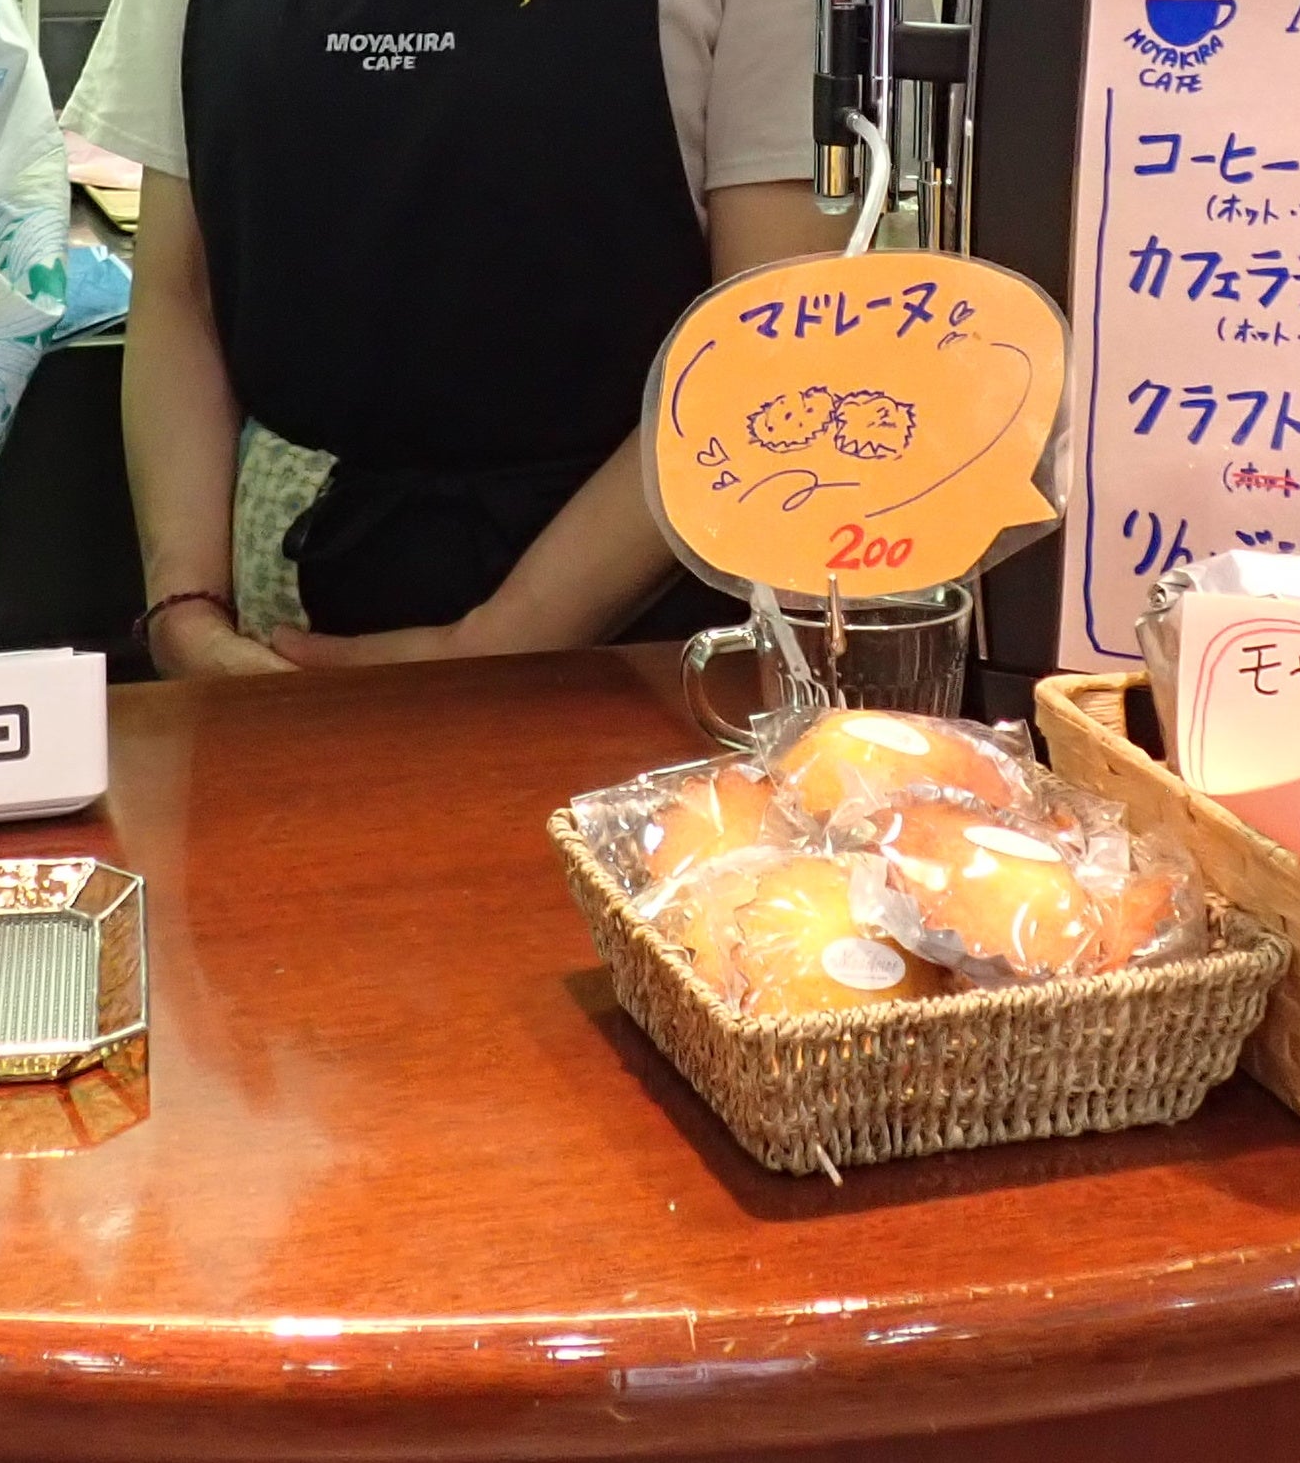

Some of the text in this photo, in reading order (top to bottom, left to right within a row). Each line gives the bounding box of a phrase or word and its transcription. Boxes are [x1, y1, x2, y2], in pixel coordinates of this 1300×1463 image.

[325, 32, 456, 54] MOYAKIRA
[362, 55, 417, 71] CAFE
[1123, 28, 1225, 70] MOYAKIRA
[1138, 68, 1204, 95] CAFE
[1134, 133, 1300, 183] コーヒー
[739, 282, 938, 339] マドレーヌ
[826, 524, 914, 570] 200
